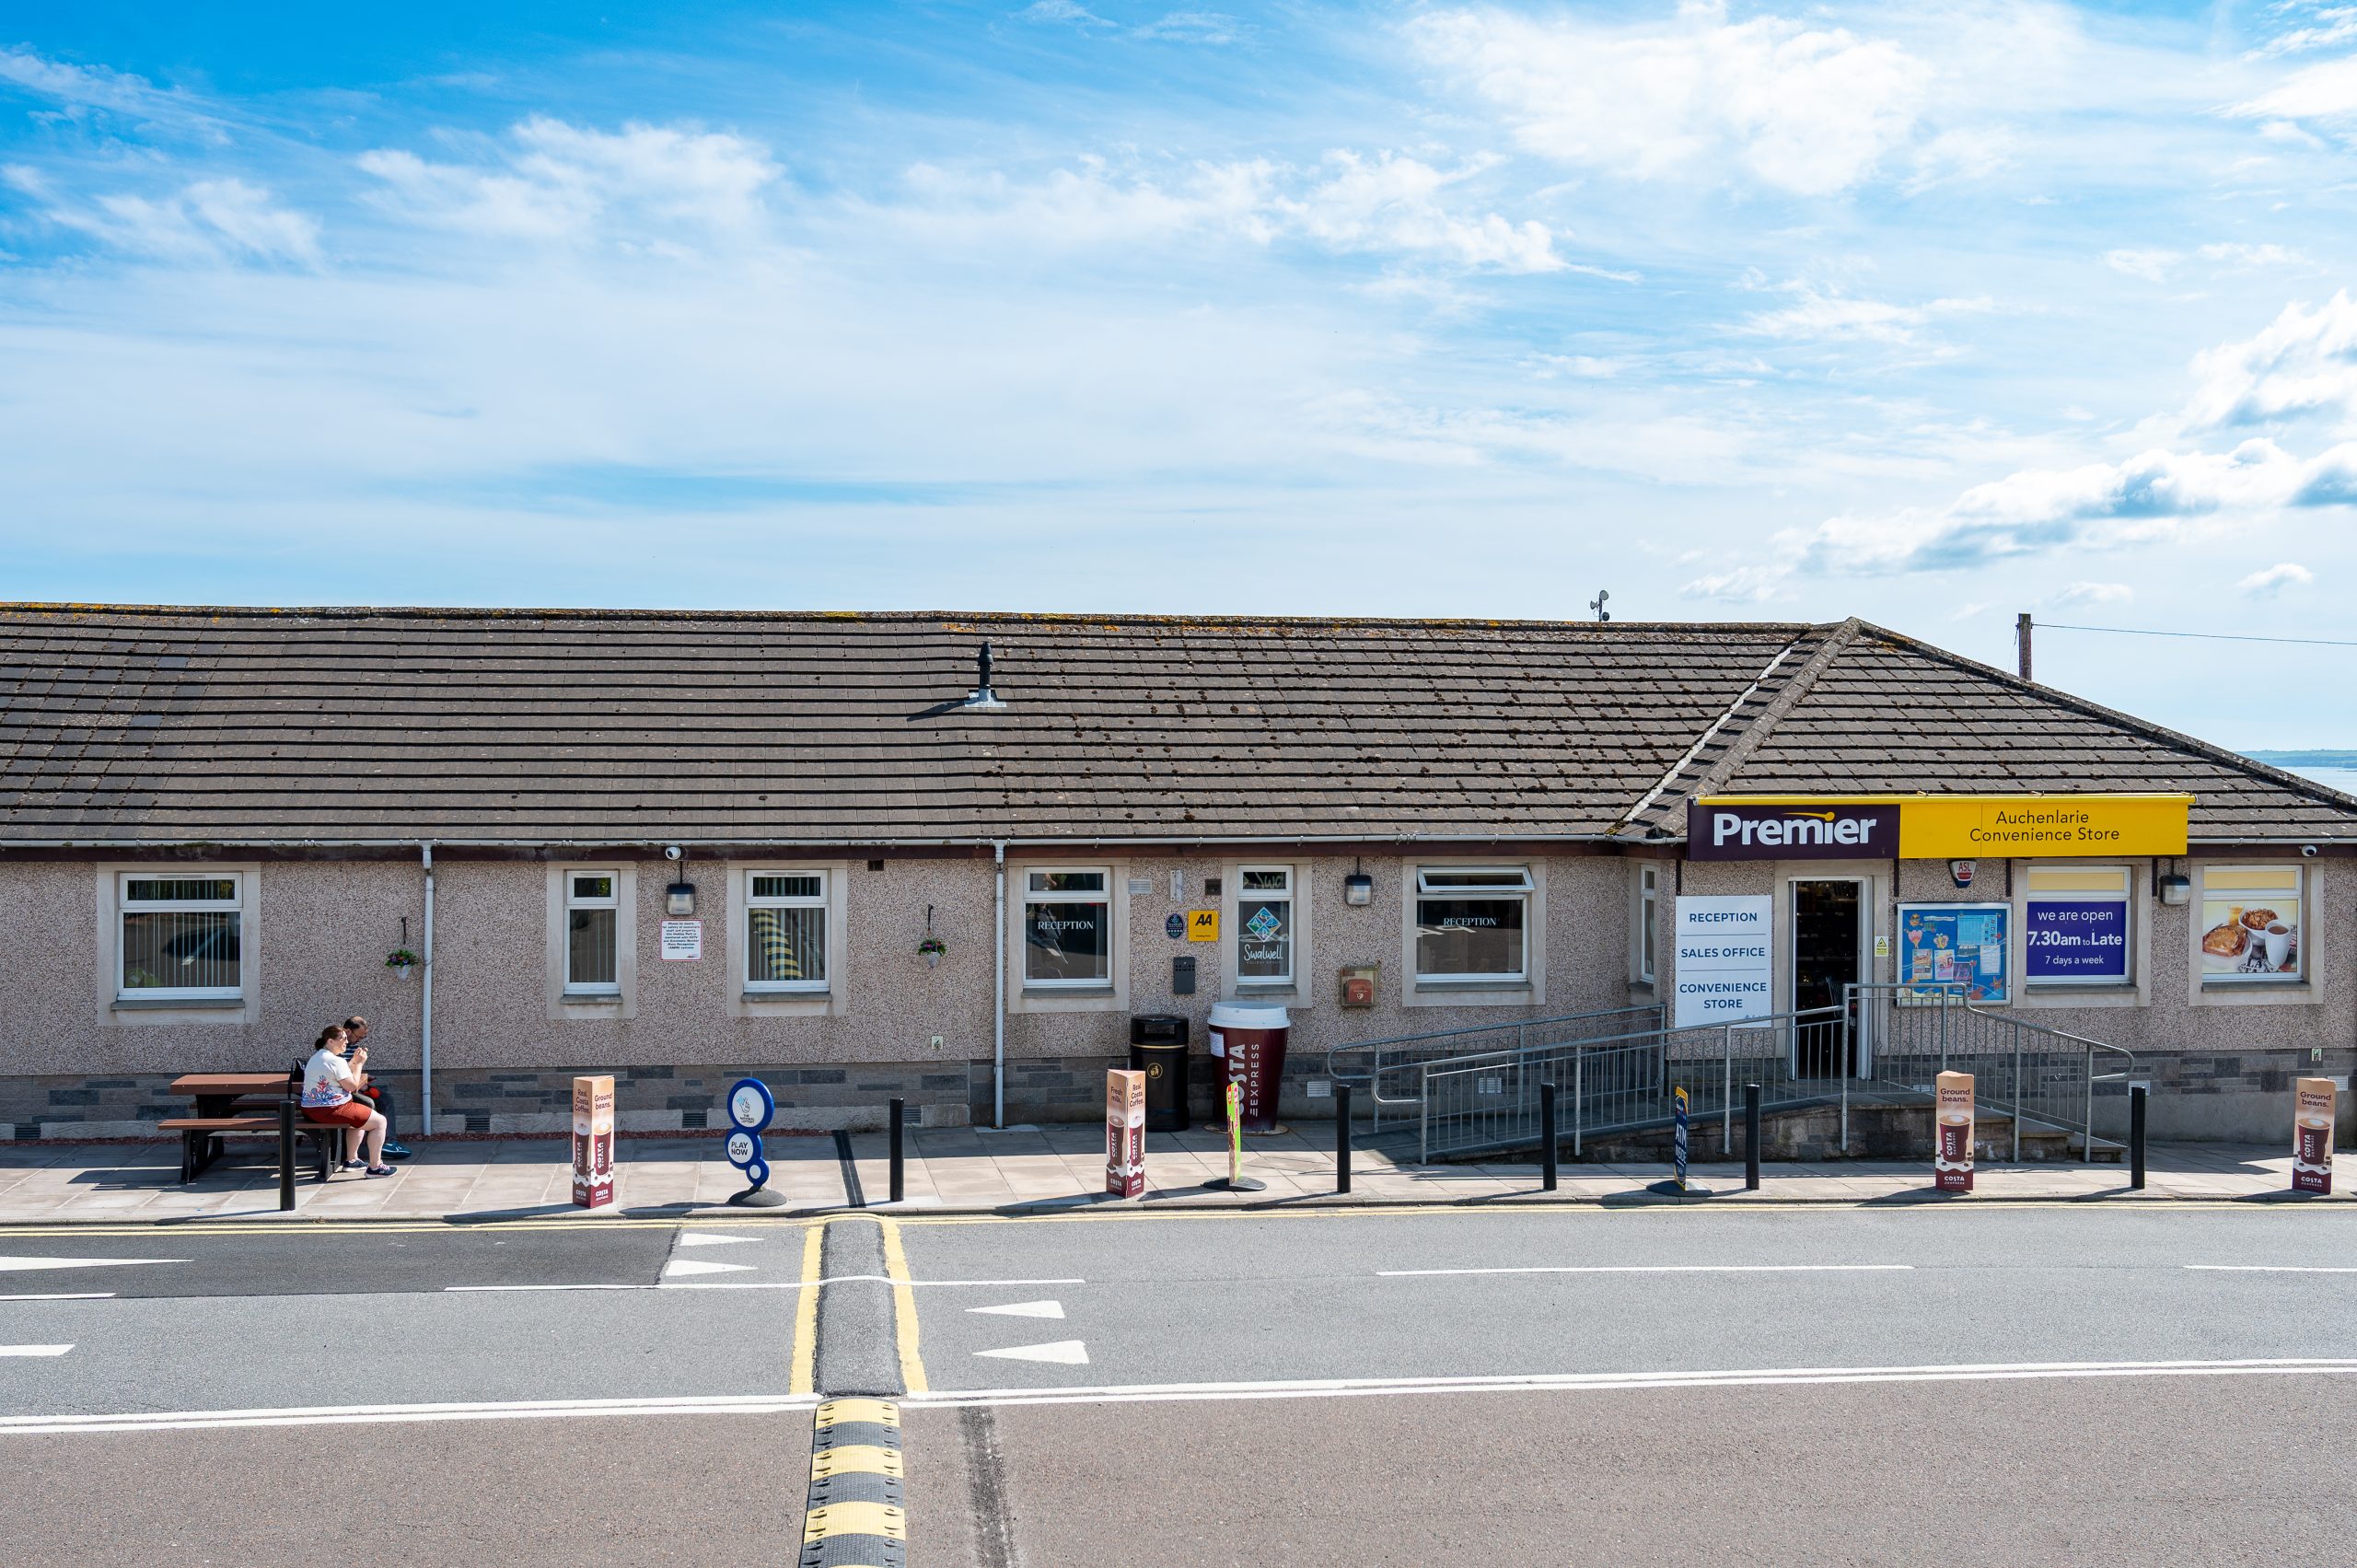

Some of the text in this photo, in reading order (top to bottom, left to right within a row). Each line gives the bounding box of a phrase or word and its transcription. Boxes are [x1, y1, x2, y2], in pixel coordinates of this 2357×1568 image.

[1996, 809, 2089, 824] Auchenlarie
[1713, 813, 1877, 846] Premier
[1970, 827, 2119, 841] Convenience Store
[1959, 862, 1971, 872] ASL
[1195, 914, 1212, 926] AA
[1444, 917, 1496, 926] RECEPTION
[1689, 912, 1758, 922] RECEPTION
[2038, 912, 2113, 923] we are open
[1038, 921, 1093, 930] RECEPTION
[2028, 931, 2080, 946] 7.30am
[2091, 932, 2122, 946] Late
[1244, 944, 1283, 961] Swalwell
[1681, 947, 1765, 958] SALES OFFICE
[2045, 956, 2051, 964] 7
[2053, 955, 2072, 966] days
[2082, 955, 2104, 964] week
[1680, 982, 1767, 993] CONVENIENCE
[1704, 999, 1743, 1009] STORE
[1250, 1044, 1260, 1106] EXPRESS
[1111, 1086, 1123, 1096] Fresh
[2300, 1092, 2331, 1100] Ground
[576, 1097, 589, 1105] Costa
[595, 1092, 612, 1102] Ground
[2302, 1099, 2329, 1107] beans.
[1676, 1123, 1686, 1148] ATM
[596, 1189, 609, 1197] COSTA
